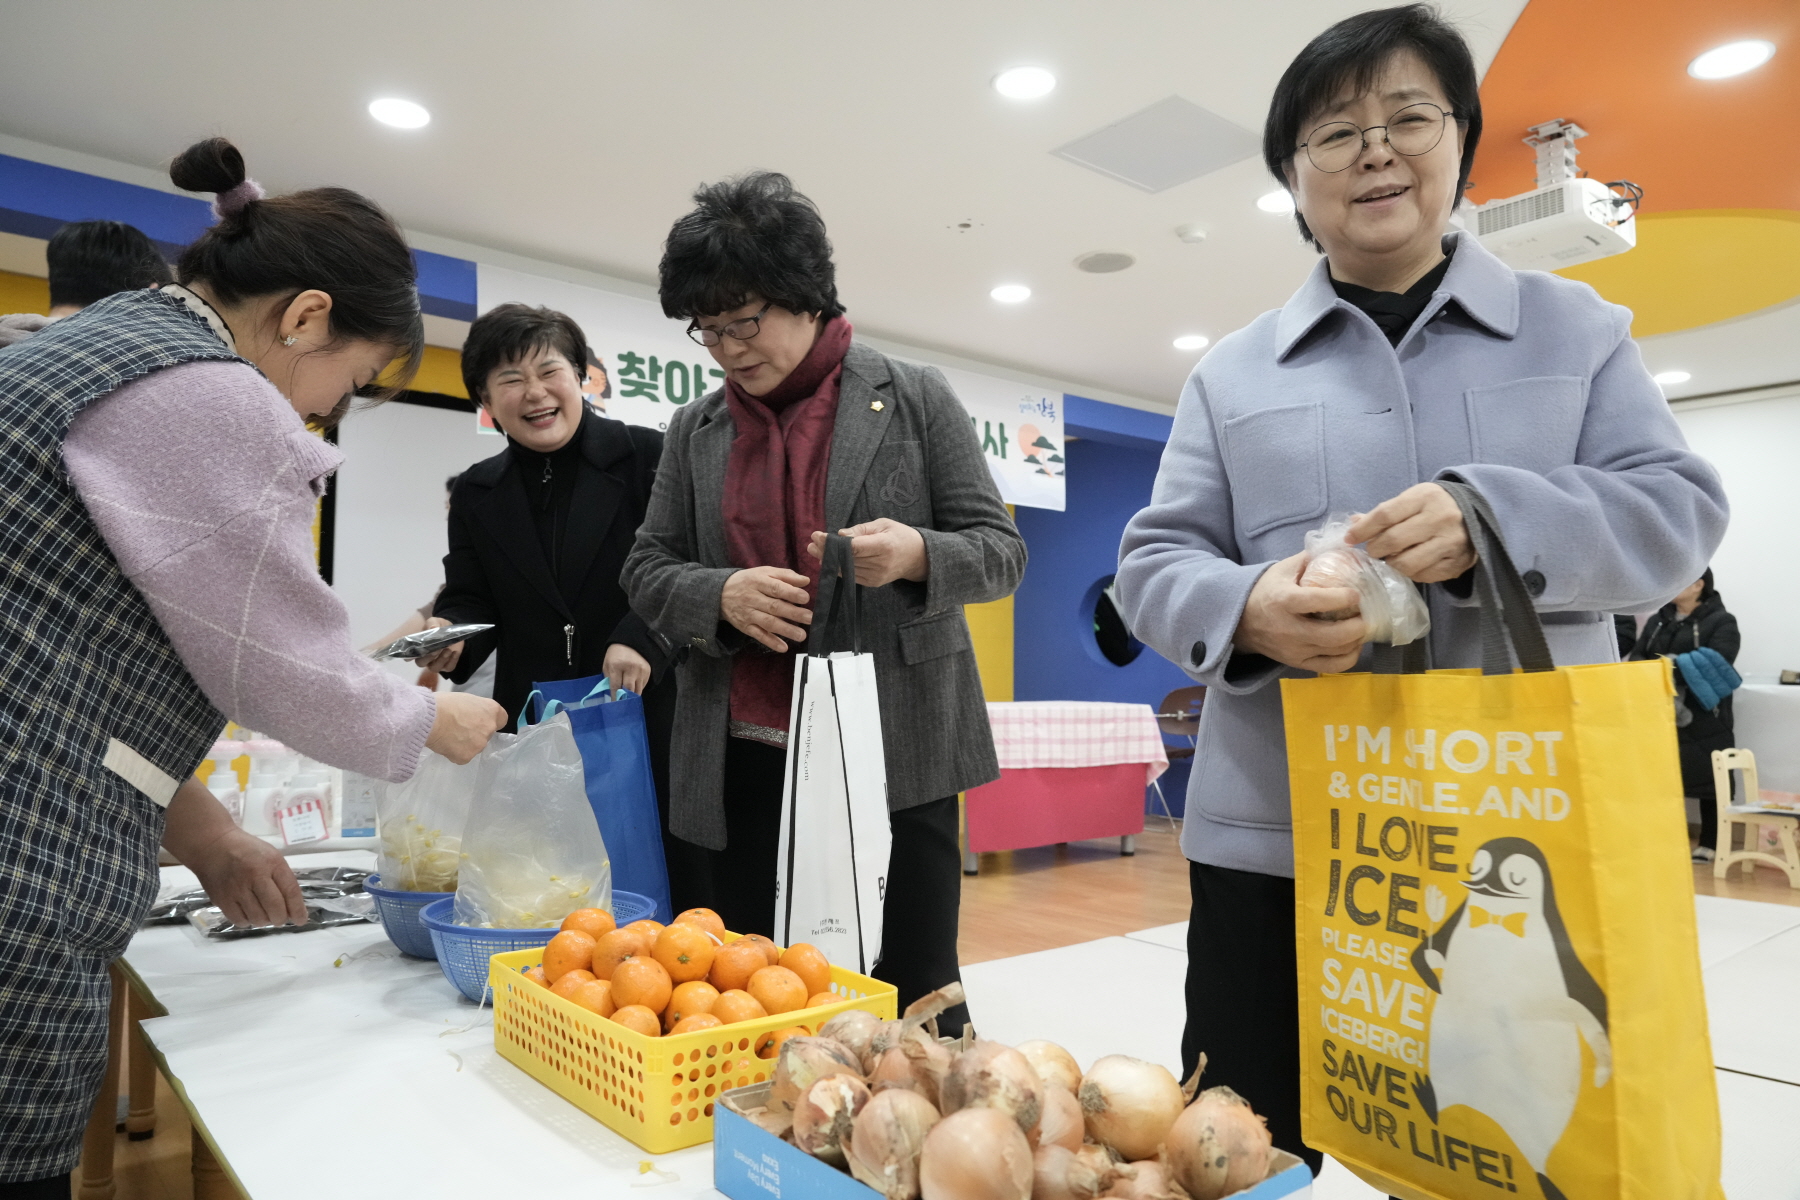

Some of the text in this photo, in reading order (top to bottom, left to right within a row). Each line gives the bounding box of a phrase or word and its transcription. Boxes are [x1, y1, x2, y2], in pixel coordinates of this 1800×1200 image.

[617, 351, 727, 404] 찾아
[1323, 724, 1563, 776] I'M SHORT
[1328, 771, 1351, 799] &
[1330, 808, 1459, 873] I LOVE
[1321, 927, 1408, 971] PLEASE
[1320, 958, 1425, 1031] SAVE
[1321, 1004, 1425, 1068] ICEBERG!
[1322, 1039, 1410, 1110] SAVE
[1325, 1084, 1518, 1194] OUR LIFE!
